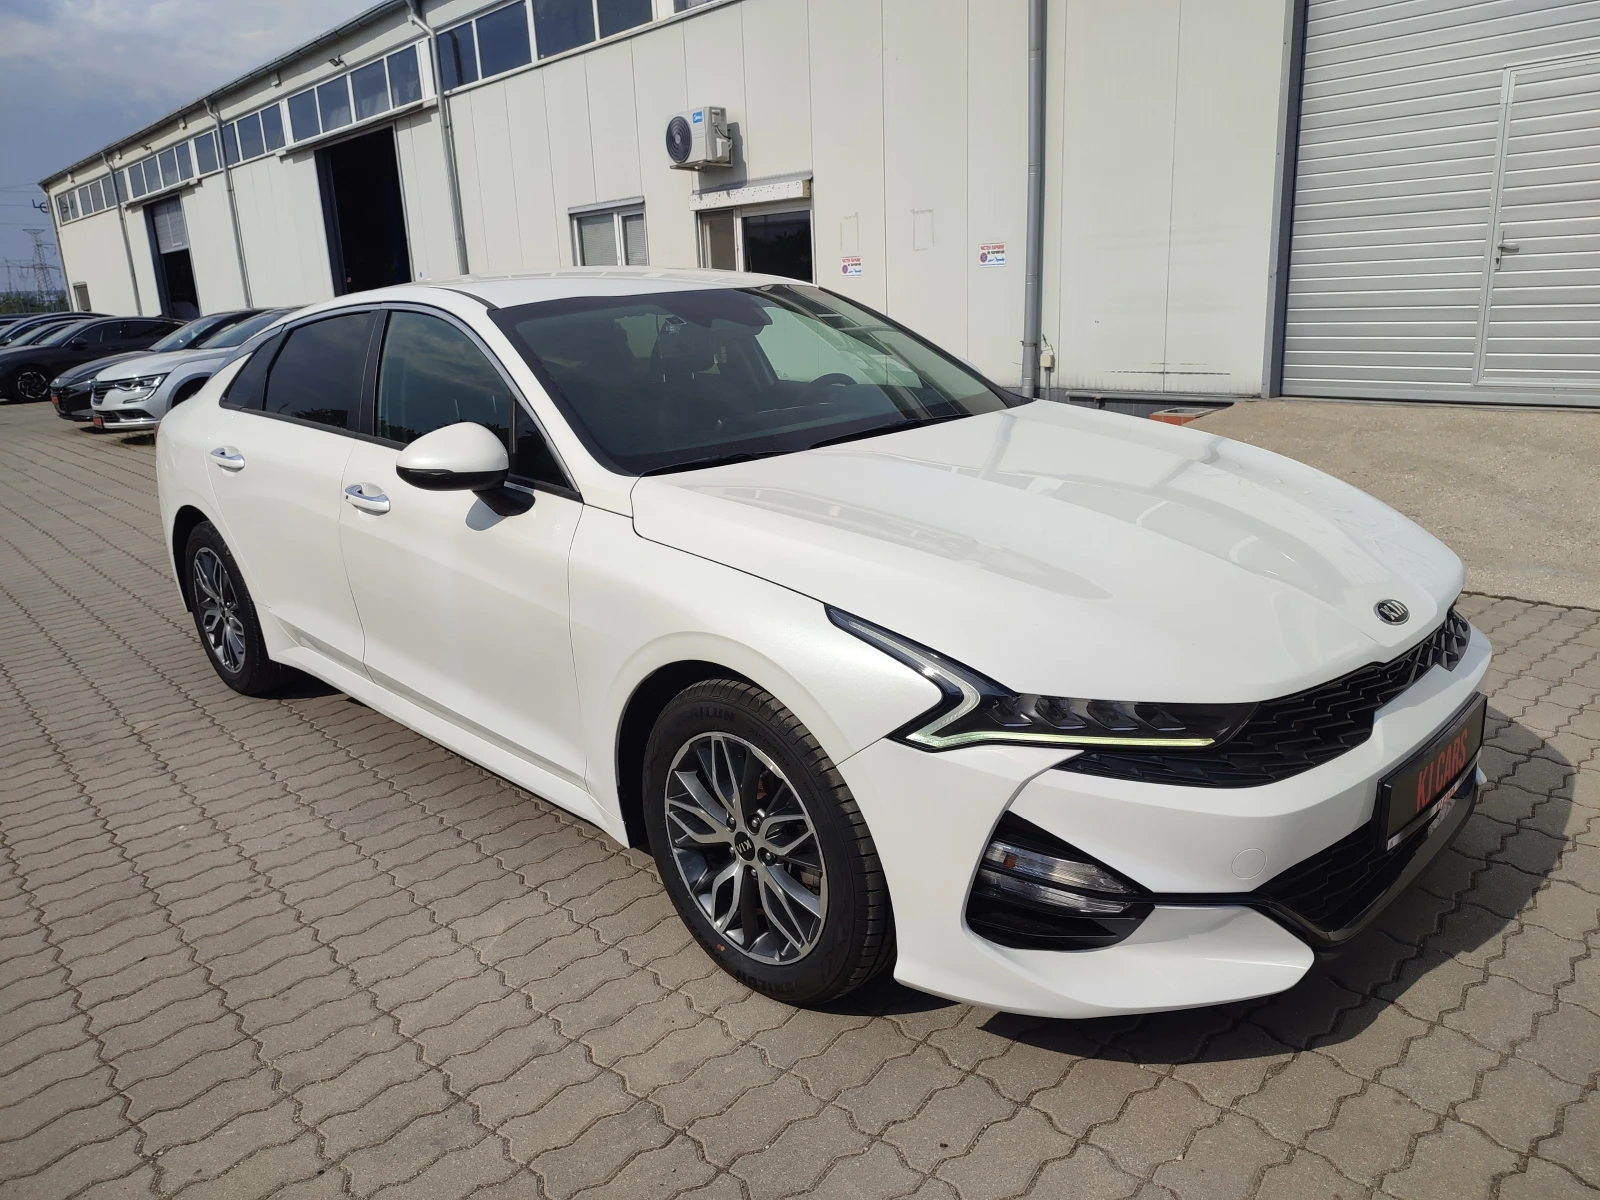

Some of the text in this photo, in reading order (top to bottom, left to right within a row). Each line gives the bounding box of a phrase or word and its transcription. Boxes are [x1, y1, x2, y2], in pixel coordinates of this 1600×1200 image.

[1379, 600, 1407, 620] KIA
[680, 706, 735, 723] SAILUN
[1436, 728, 1468, 791] CARS
[735, 839, 752, 854] KIA
